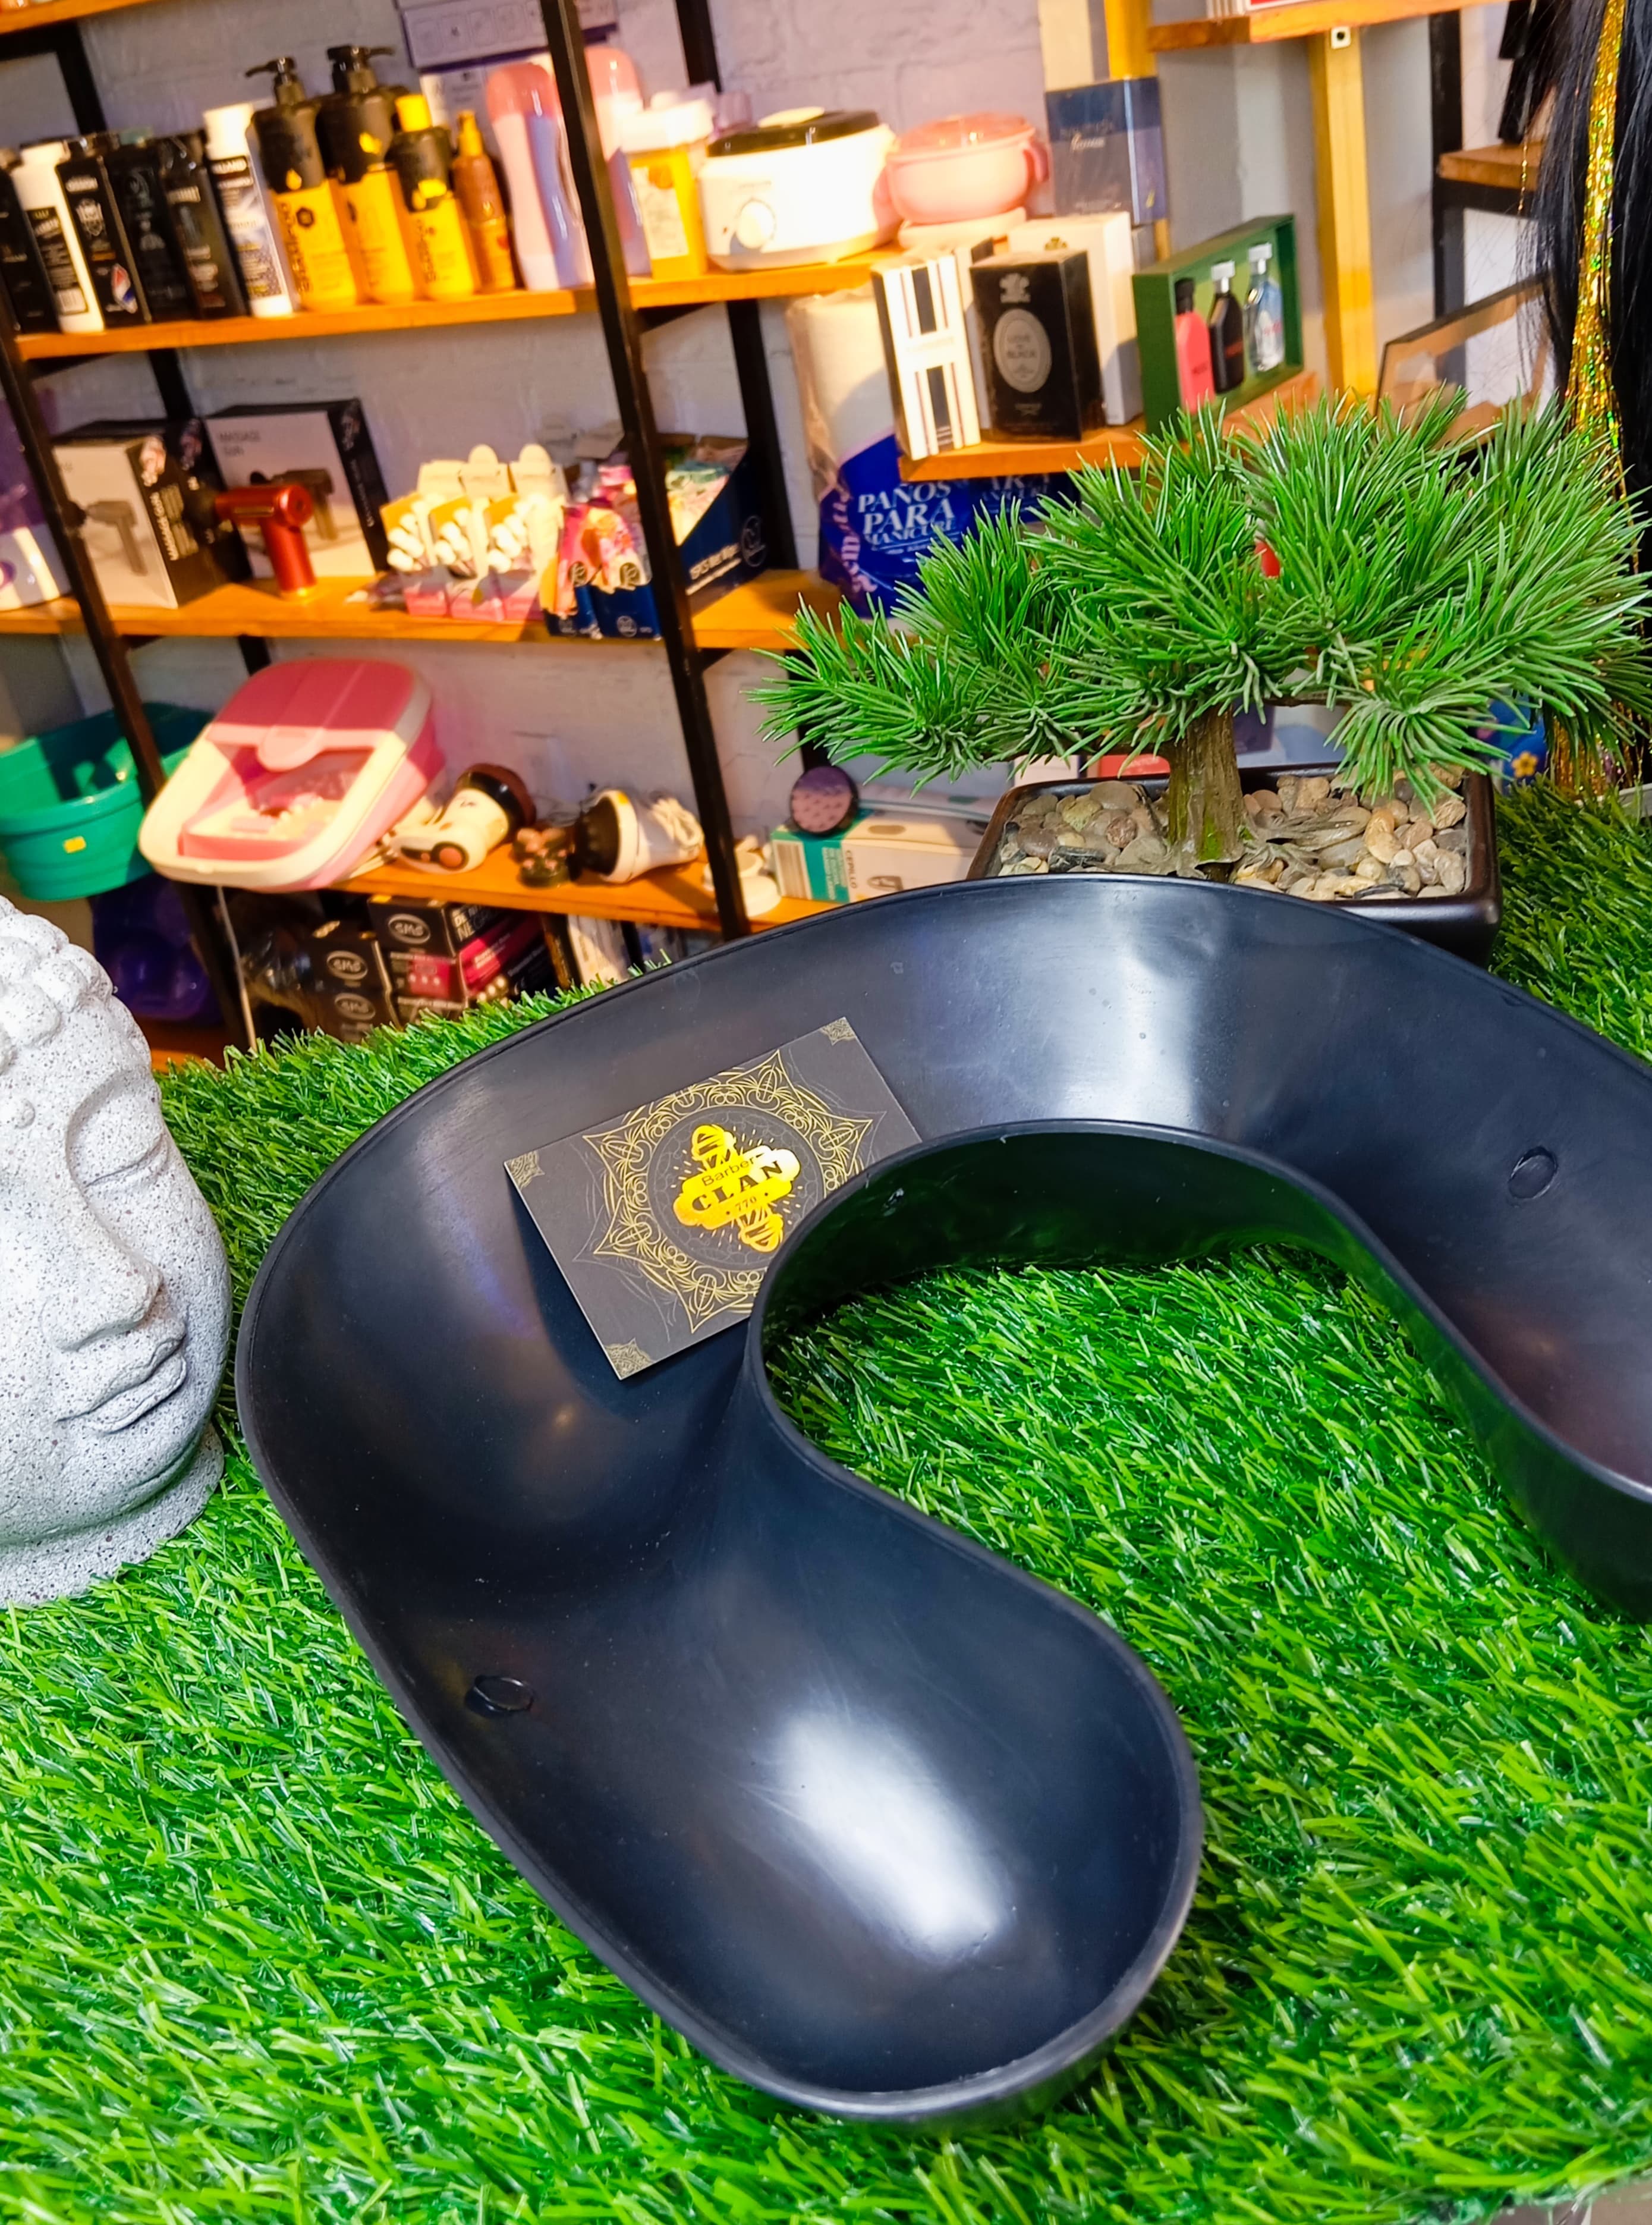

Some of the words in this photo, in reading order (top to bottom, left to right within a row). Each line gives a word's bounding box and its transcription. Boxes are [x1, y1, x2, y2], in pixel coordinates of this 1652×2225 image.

[863, 498, 955, 535] PARA
[846, 850, 858, 889] CEPILLO
[692, 1160, 783, 1211] CLAN
[701, 1157, 756, 1186] Barber
[735, 1196, 757, 1211] 770
